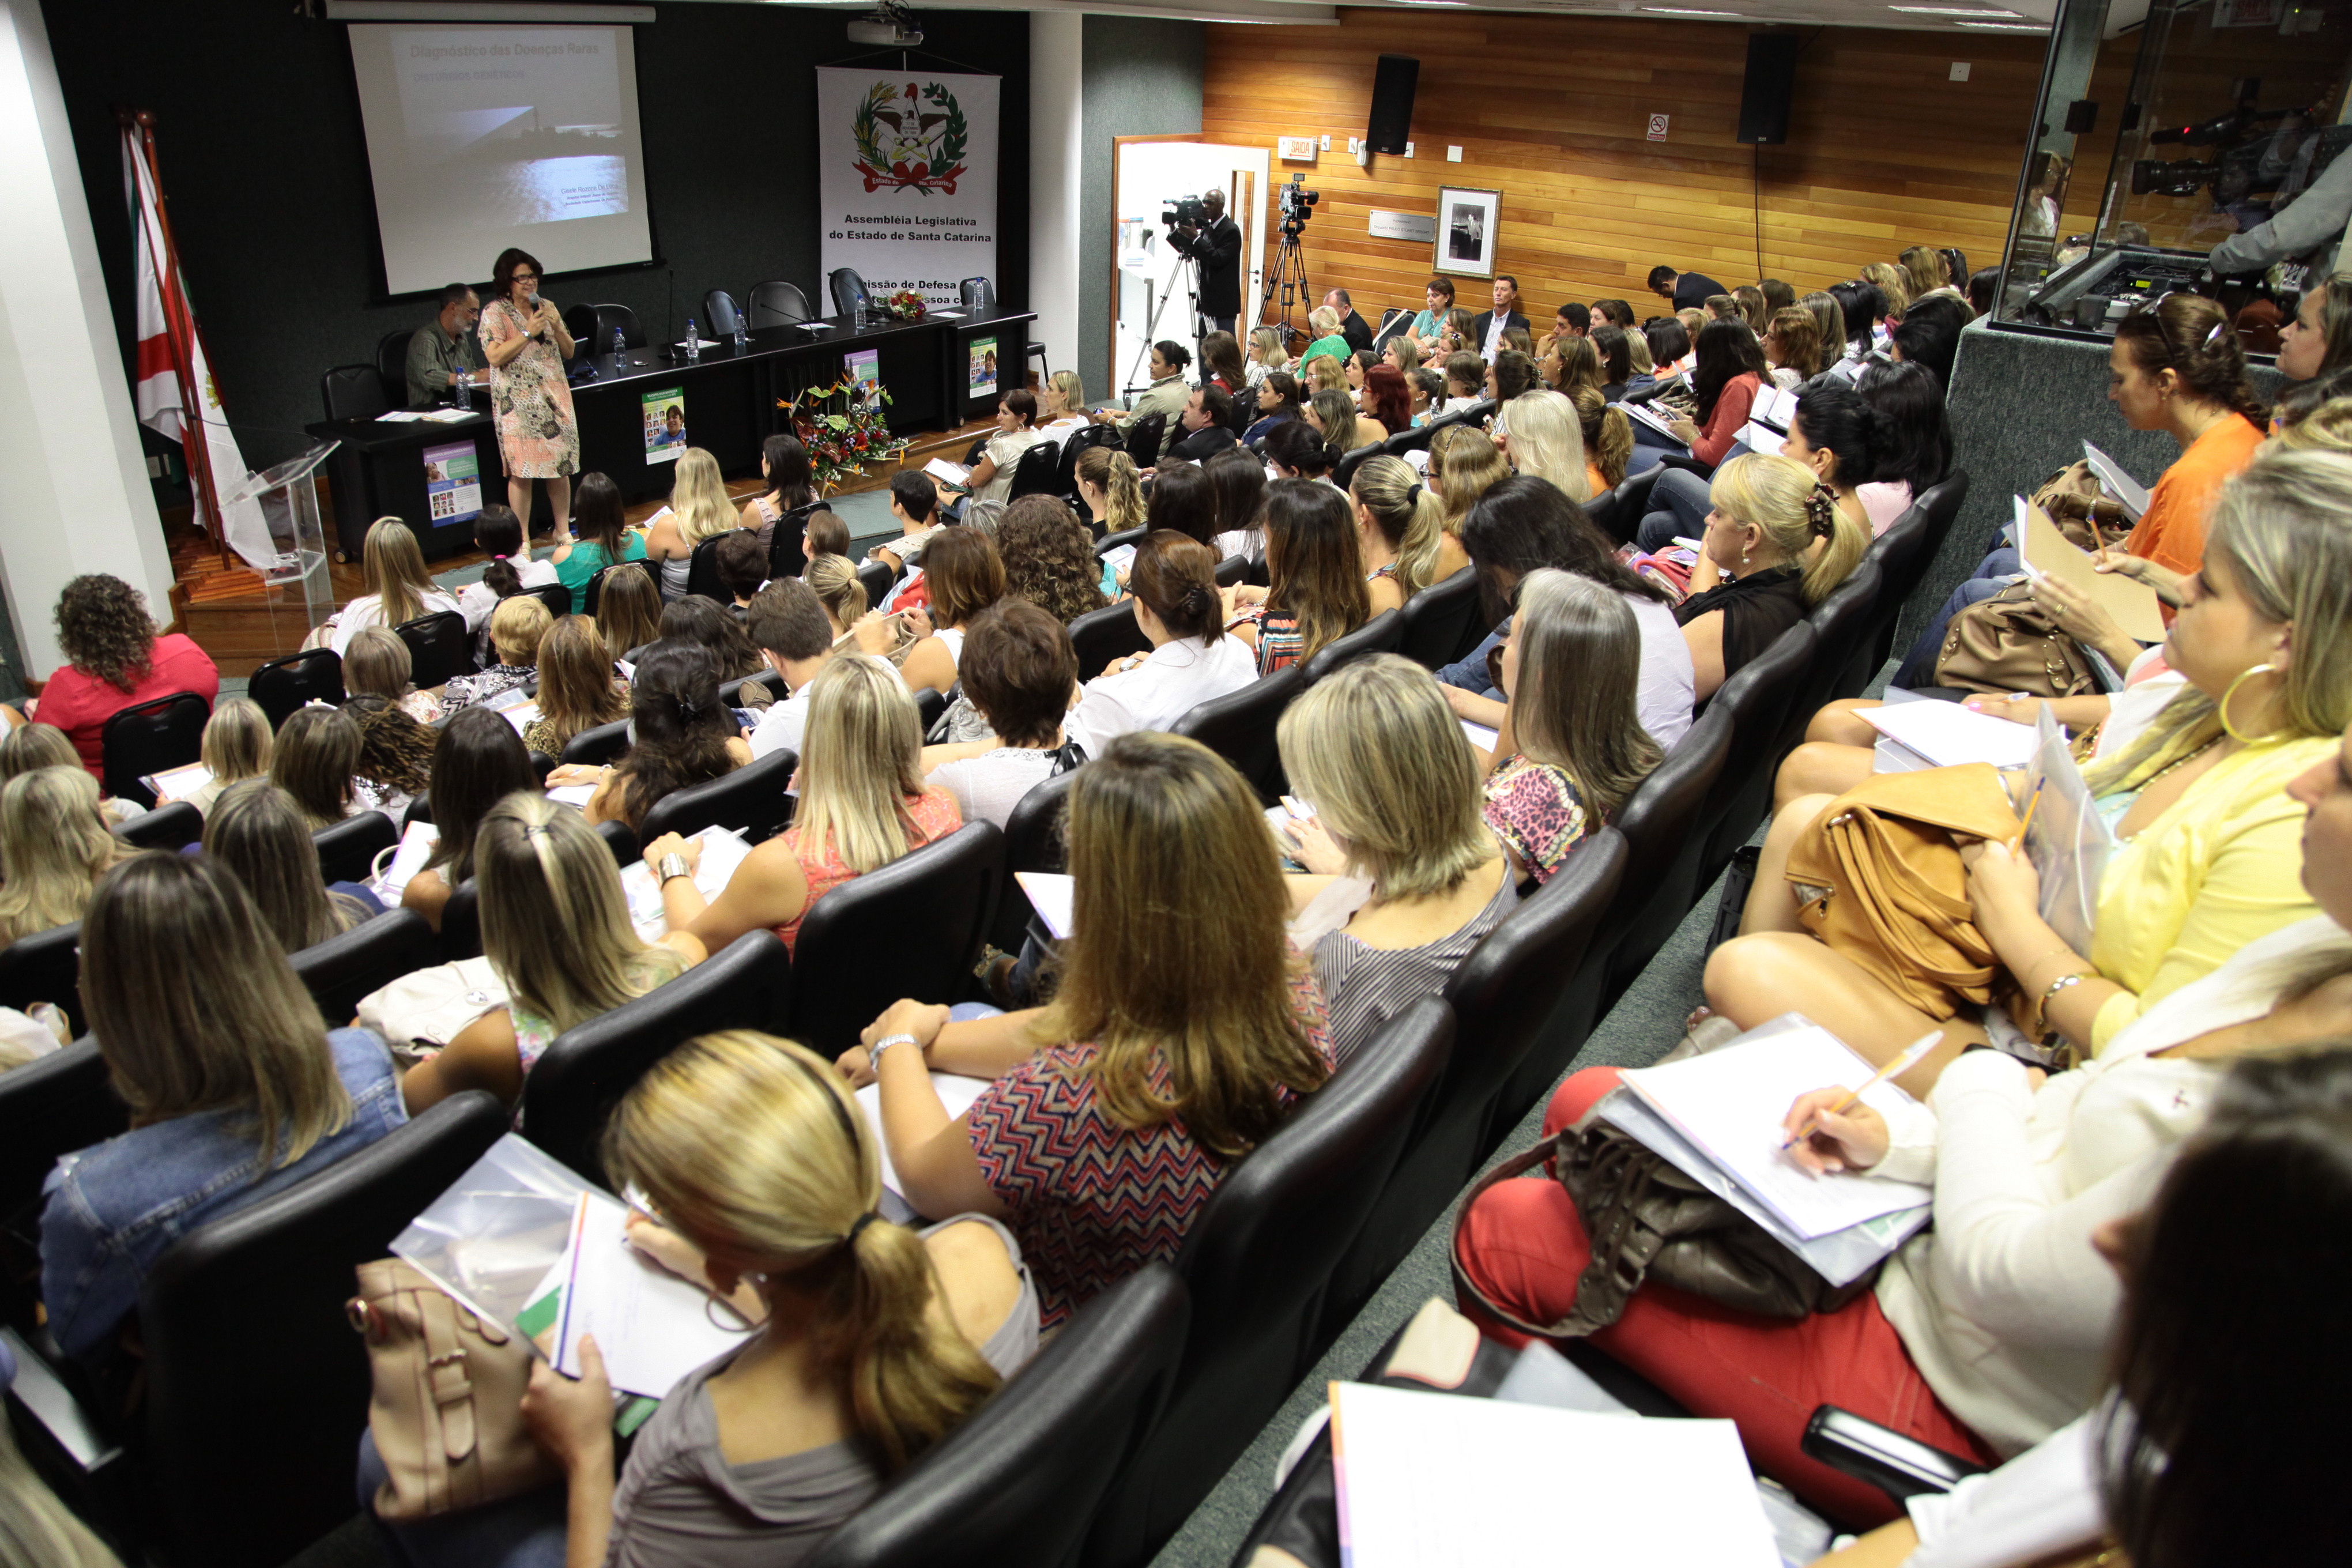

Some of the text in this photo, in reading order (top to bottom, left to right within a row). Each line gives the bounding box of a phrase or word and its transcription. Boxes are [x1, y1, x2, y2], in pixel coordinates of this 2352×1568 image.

[410, 43, 599, 61] Diagnóstico das Doenças Raras
[1291, 141, 1309, 154] SAÍDA
[929, 180, 952, 188] Catarina
[845, 214, 977, 227] Assembléia Legislativa
[829, 230, 992, 242] do Estado de Santa Catarina
[864, 280, 956, 289] issão de Defesa
